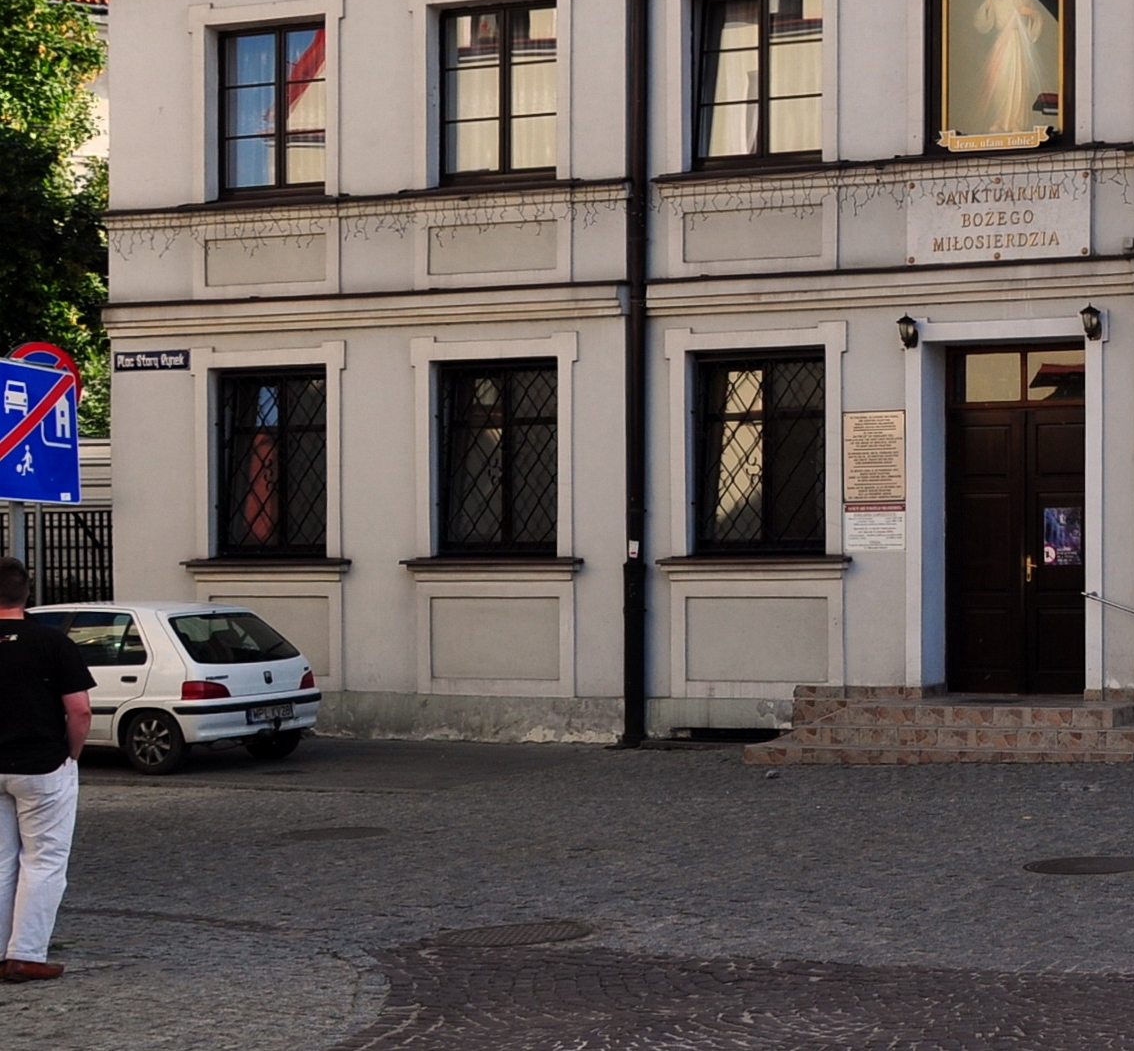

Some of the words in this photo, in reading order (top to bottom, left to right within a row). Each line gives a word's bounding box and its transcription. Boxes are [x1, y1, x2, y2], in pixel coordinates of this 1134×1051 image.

[980, 139, 1003, 147] ufam
[1006, 135, 1034, 145] Tobie!
[935, 185, 1060, 206] SANKTUARIUM
[961, 208, 1034, 228] BOŻEGO
[932, 231, 1060, 252] MIŁOSIERDZIA
[117, 355, 135, 368] Plac
[136, 354, 159, 368] Stary
[160, 353, 185, 368] Rynek
